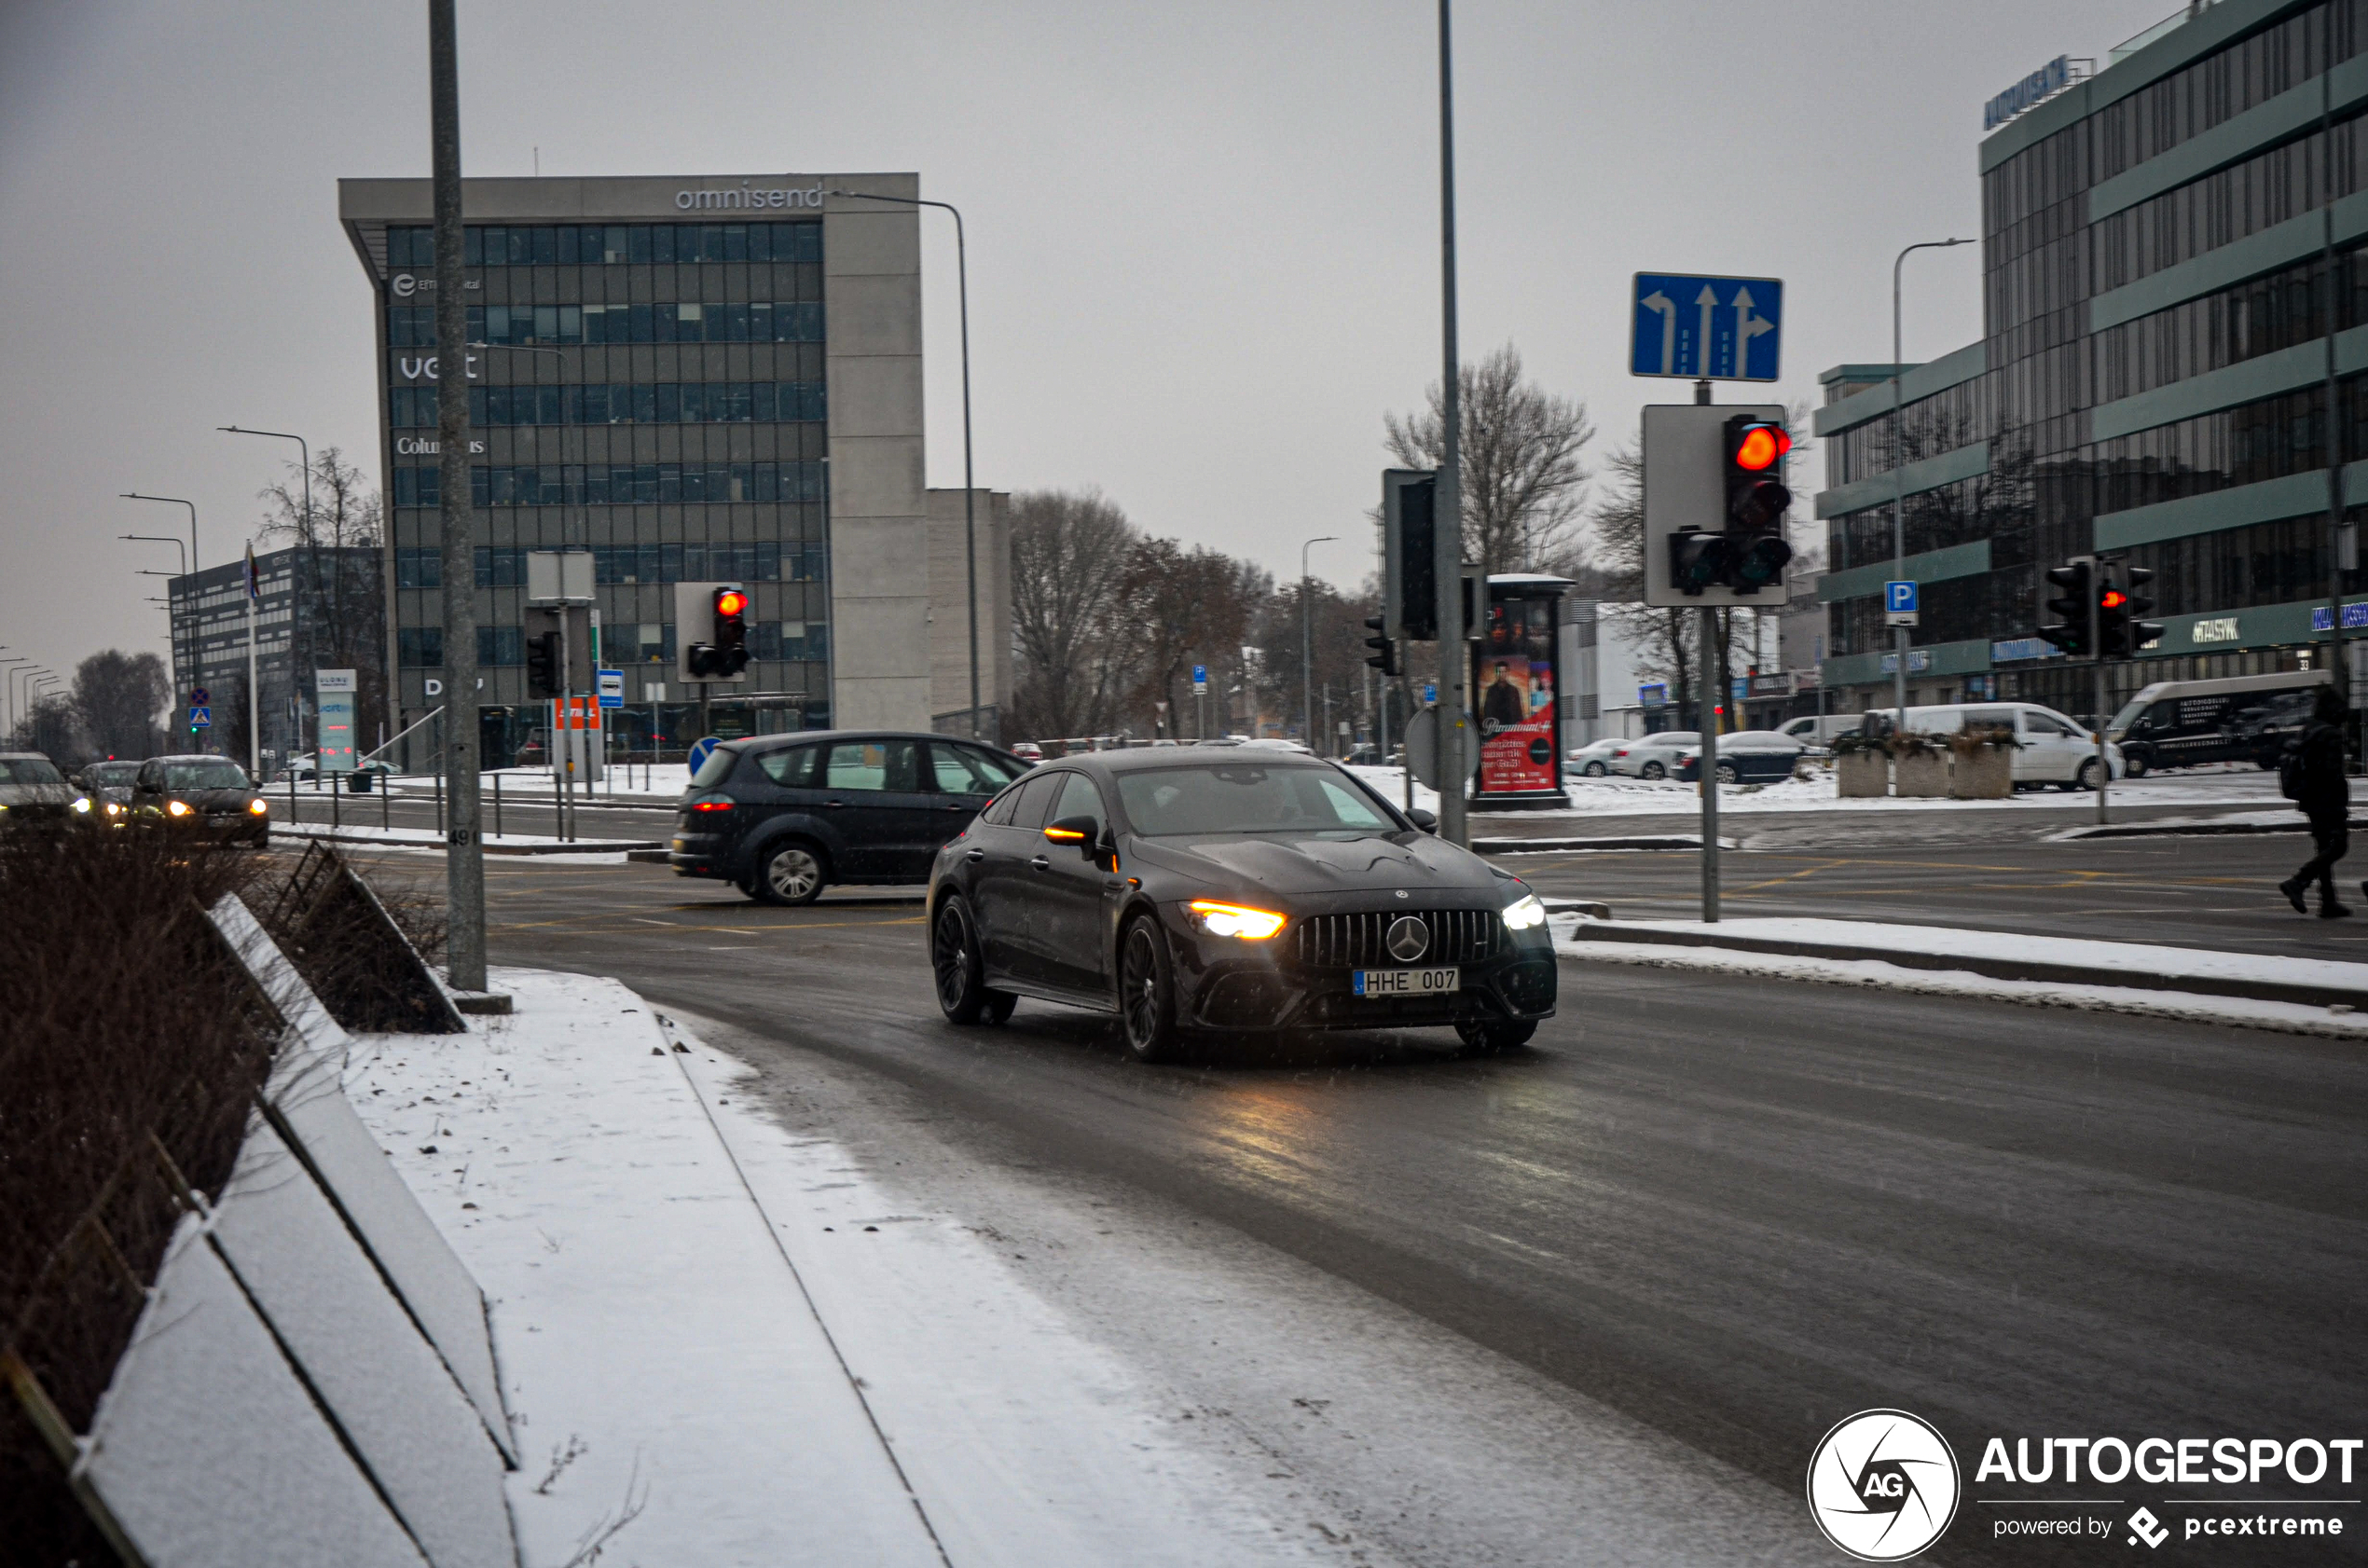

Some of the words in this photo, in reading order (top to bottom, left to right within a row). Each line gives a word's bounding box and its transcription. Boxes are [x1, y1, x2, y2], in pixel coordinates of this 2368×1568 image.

[675, 180, 822, 209] omnisend
[1894, 585, 1913, 609] P
[1367, 972, 1410, 991] HHE
[1423, 970, 1455, 989] 007
